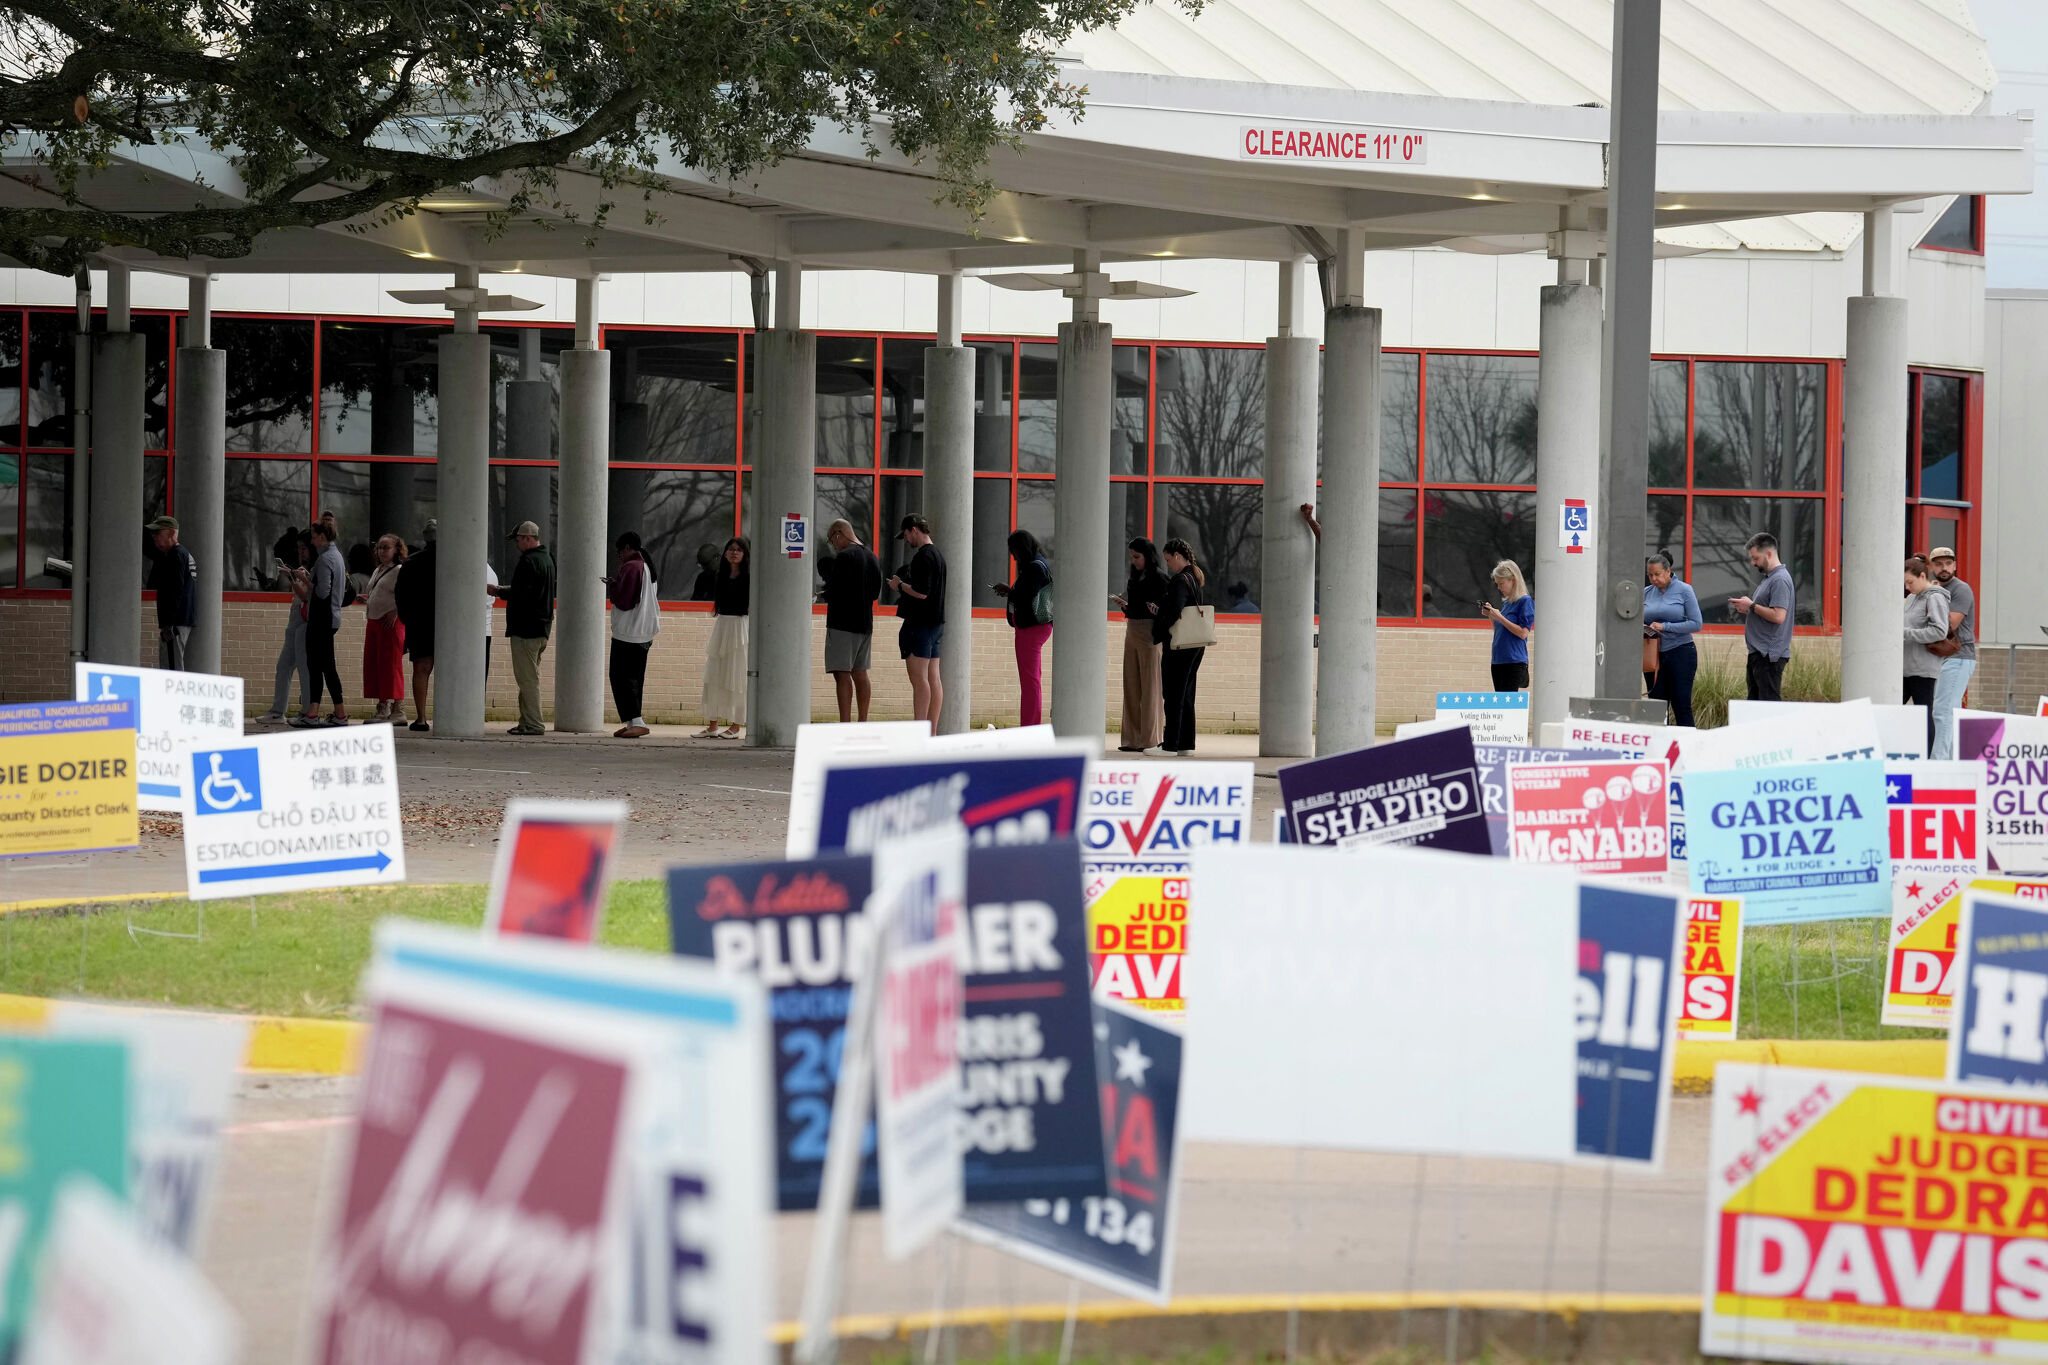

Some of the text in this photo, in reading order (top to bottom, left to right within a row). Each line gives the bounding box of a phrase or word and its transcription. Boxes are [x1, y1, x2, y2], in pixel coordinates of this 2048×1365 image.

[1245, 129, 1423, 161] CLEARANCE 11' 0"
[165, 678, 236, 701] PARKING
[0, 708, 42, 720] UALIFIED,
[54, 716, 109, 729] CANDIDATE
[180, 704, 235, 729] 停車處
[1459, 711, 1504, 721] Voting this way
[290, 735, 384, 760] PARKING
[1477, 734, 1491, 743] Theo
[1572, 729, 1652, 747] RE-ELECT
[1474, 747, 1570, 764] RE-ELECT
[1734, 748, 1794, 769] BEVERLY
[1981, 744, 2048, 759] GLORIA
[38, 758, 127, 783] DOZIER
[311, 763, 385, 791] 停車處
[1512, 766, 1590, 780] CONSERVATIVE
[1089, 786, 1245, 807] DGE JIM F.
[1337, 783, 1387, 807] JUDGE
[1387, 773, 1430, 795] LEAH
[1513, 778, 1561, 790] VETERAN
[1753, 776, 1818, 796] JORGE
[0, 801, 130, 823] ounty District Clerk
[363, 801, 388, 820] XE
[1305, 780, 1469, 846] SHAPIRO
[1515, 808, 1590, 827] BARRETT
[1711, 793, 1863, 829] GARCIA
[1083, 808, 1241, 857] OVACH
[1515, 825, 1666, 863] McNABB
[1739, 827, 1836, 860] DIAZ
[196, 829, 391, 862] ESTACIONAMIENTO
[1757, 860, 1824, 873] FOR JUDGE
[1130, 903, 1188, 922] JUD
[1896, 878, 1960, 936] RE-ELECT
[712, 899, 1062, 986] PLUER
[1096, 924, 1188, 950] DED
[1576, 950, 1665, 1052] ell
[1937, 1098, 2048, 1136] CIVIL
[1724, 1082, 1833, 1187] RE-ELECT
[1875, 1134, 2048, 1179] JUDGE
[1813, 1167, 2048, 1234] DEDRA
[1082, 1196, 1156, 1255] 134
[1733, 1214, 2048, 1321] DAVIS
